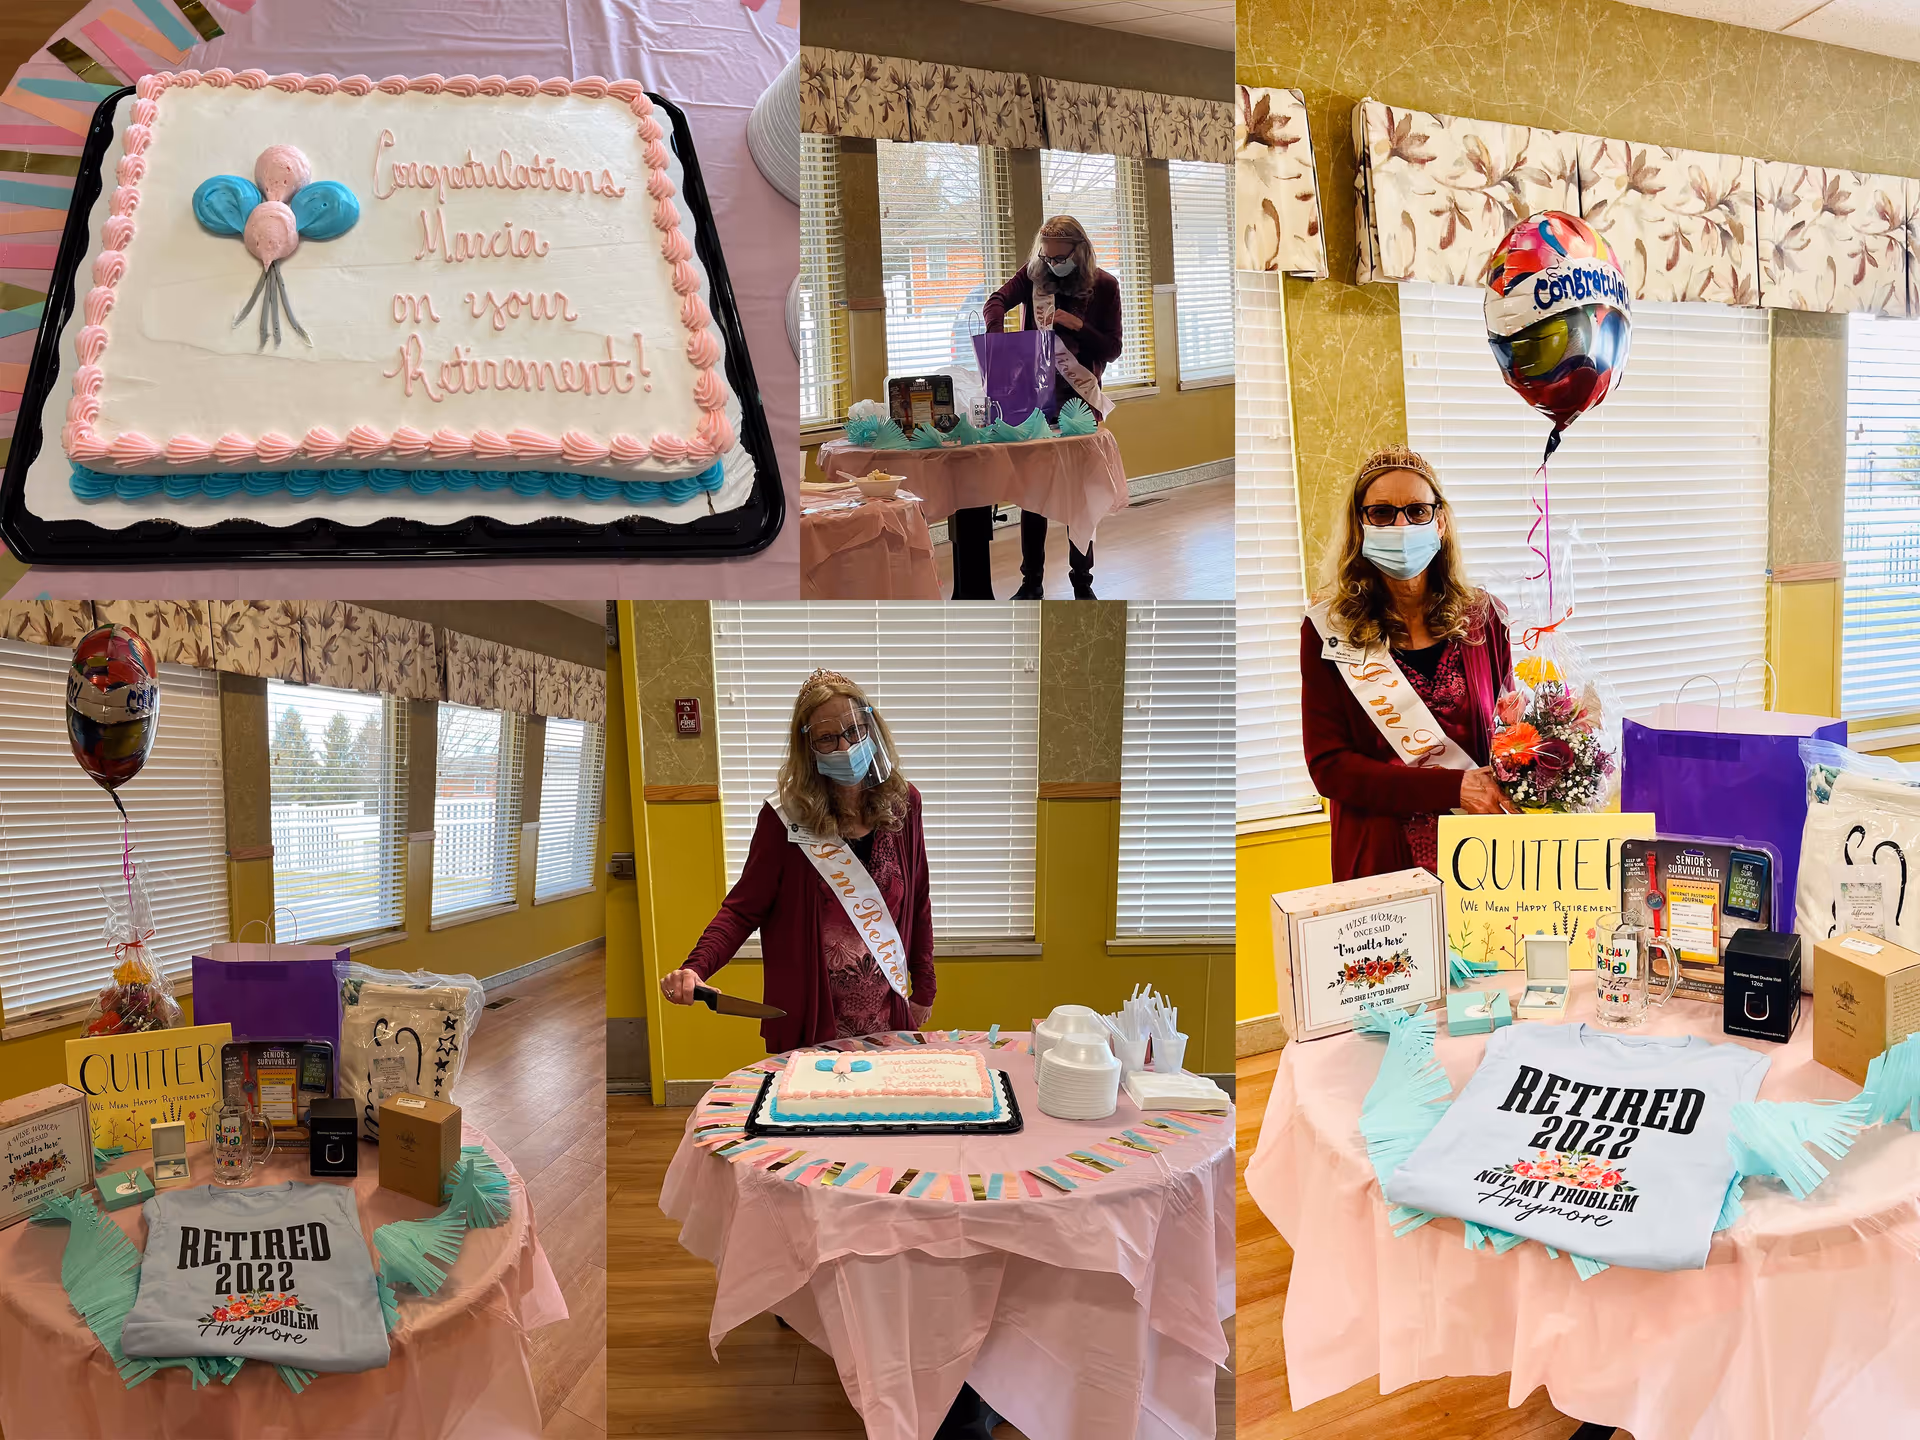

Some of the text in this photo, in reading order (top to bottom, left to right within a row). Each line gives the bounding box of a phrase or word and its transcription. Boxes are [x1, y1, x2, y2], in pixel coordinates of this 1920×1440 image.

[415, 208, 549, 263] Marcia
[393, 291, 578, 331] on your
[383, 333, 651, 402] Retirement!
[1668, 864, 1705, 877] SURVIVAL
[1707, 867, 1720, 878] KIT
[1675, 855, 1712, 868] SENIOR'S
[1735, 883, 1749, 891] COME
[1345, 915, 1368, 931] WISE
[1353, 924, 1391, 939] ONCE SAID
[1357, 938, 1383, 952] outta
[1340, 997, 1354, 1006] AND
[1354, 994, 1367, 1003] SHE
[1385, 983, 1410, 995] HAPPILY
[79, 1043, 217, 1096] QUITTER
[1497, 1064, 1706, 1135] RETIRED
[13, 1128, 30, 1143] WISE
[35, 1132, 48, 1141] SAID
[1528, 1115, 1640, 1160] 2022
[23, 1145, 43, 1158] outta
[12, 1193, 23, 1202] AND
[33, 1184, 47, 1194] LIVED
[1473, 1169, 1639, 1213] NOT MY PROBLEM
[1478, 1184, 1613, 1227] Anymore
[177, 1222, 331, 1269] RETIRED
[215, 1261, 295, 1295] 2022
[198, 1319, 307, 1345] Anymore
